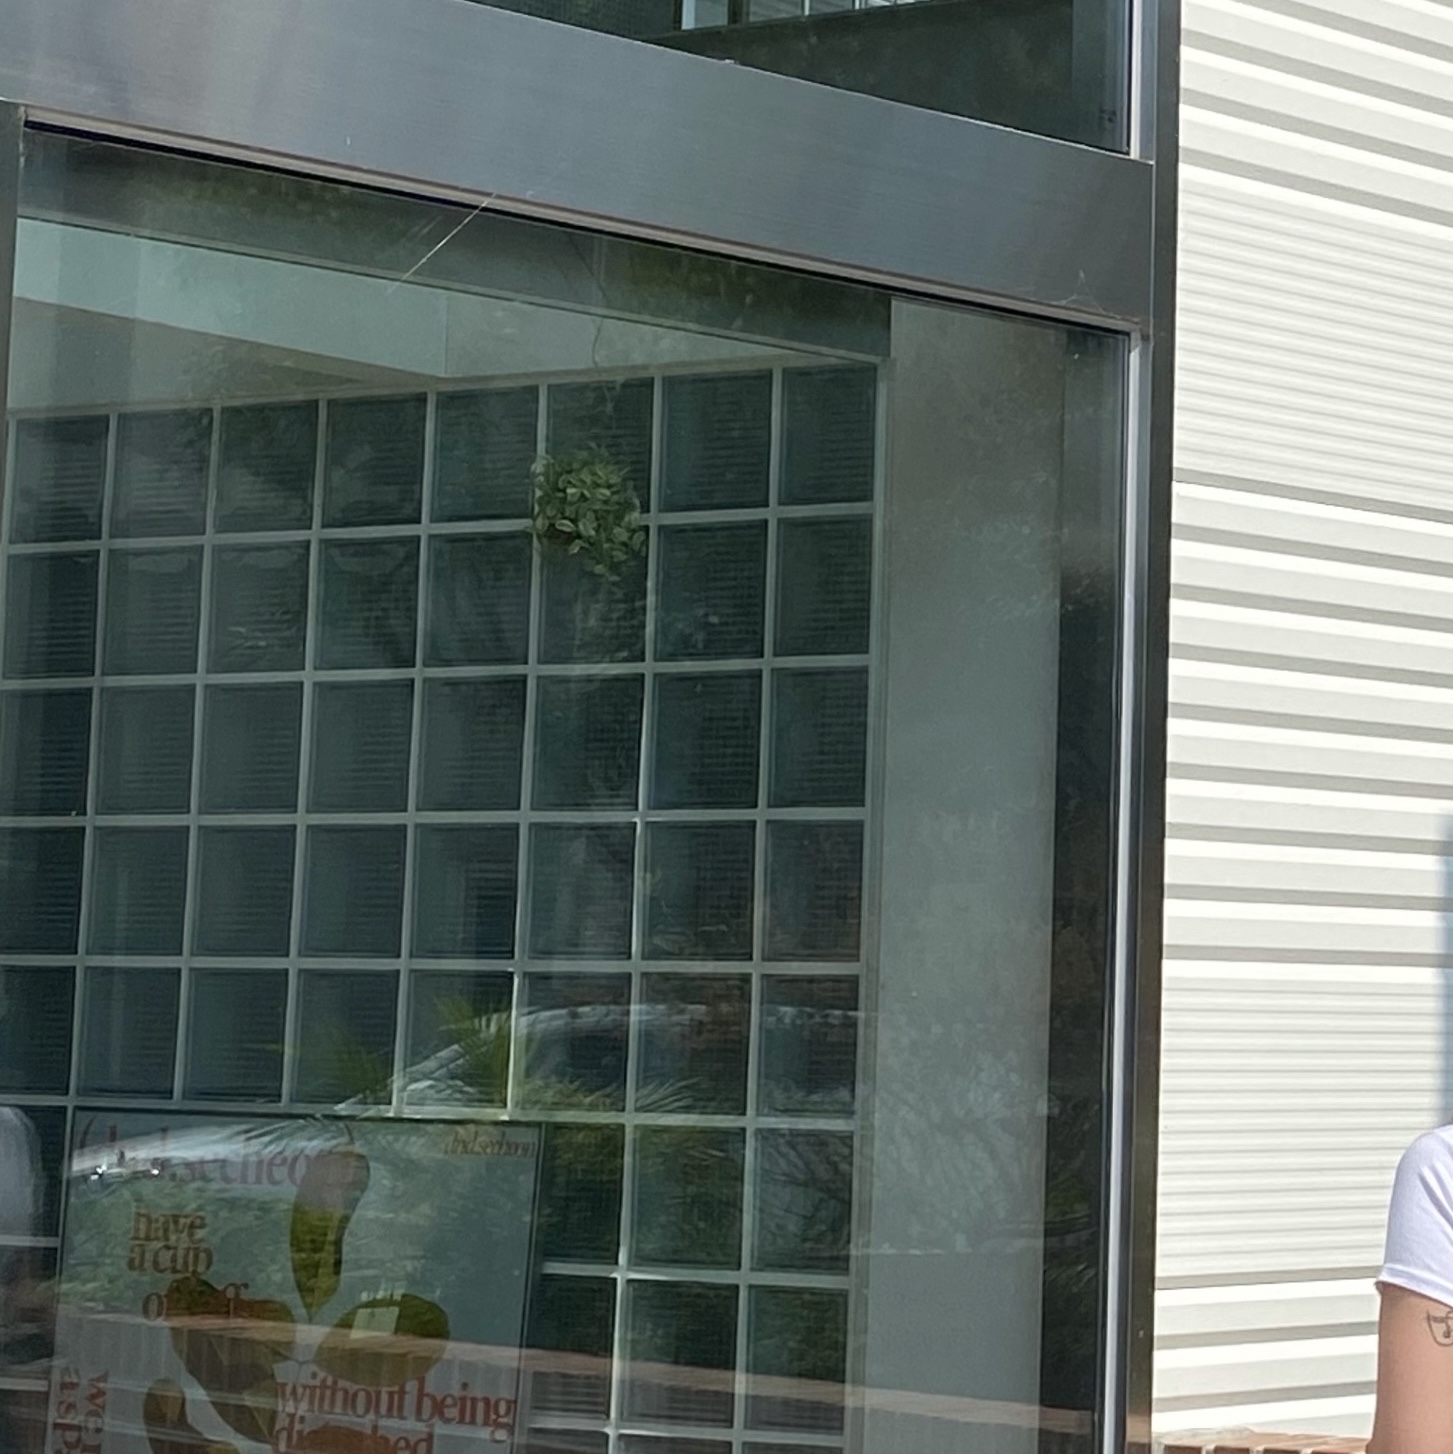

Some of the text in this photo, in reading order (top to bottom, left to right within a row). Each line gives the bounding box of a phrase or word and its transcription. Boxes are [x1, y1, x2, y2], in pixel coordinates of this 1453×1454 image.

[131, 1203, 207, 1243] have
[127, 1240, 214, 1275] a cup
[277, 1370, 515, 1443] without being
